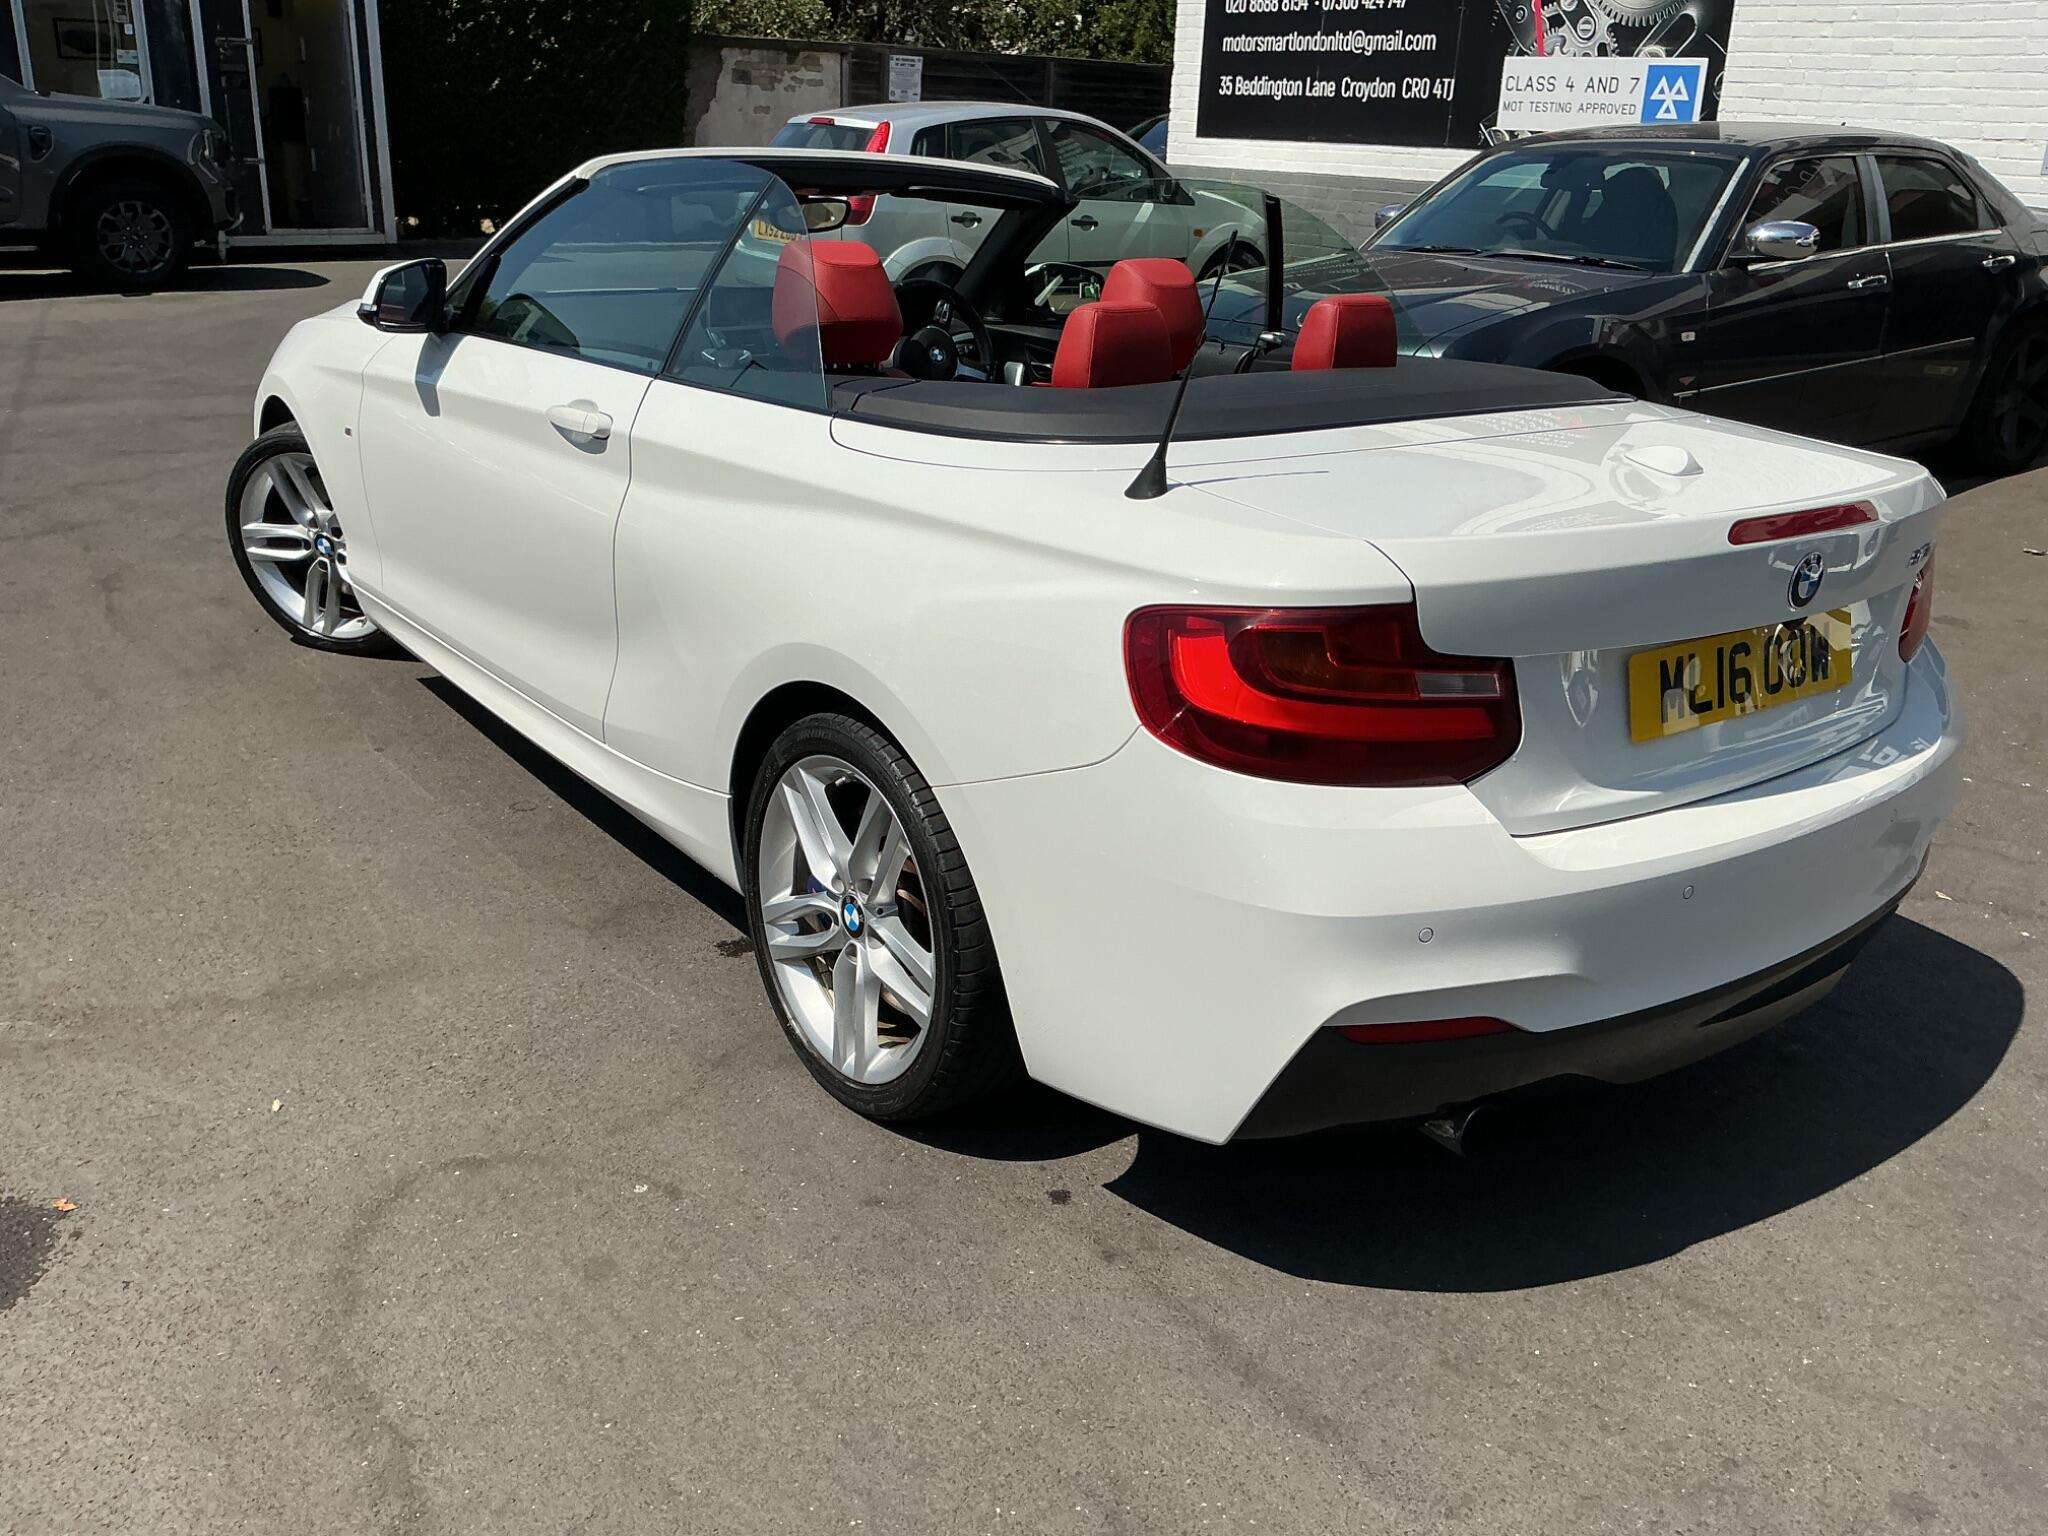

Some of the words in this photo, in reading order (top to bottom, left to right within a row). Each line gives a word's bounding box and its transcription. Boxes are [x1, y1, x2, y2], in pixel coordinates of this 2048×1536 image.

[1222, 30, 1437, 56] motorsmartlondonltd@gmail.com
[1218, 75, 1233, 96] 35
[1234, 75, 1303, 101] Beddington
[1305, 76, 1336, 97] Lane
[1341, 76, 1396, 102] Croydon
[1432, 78, 1456, 101] 4TJ
[1504, 75, 1557, 93] CLASS
[1565, 75, 1576, 93] 4
[1584, 76, 1620, 94] AND
[1628, 76, 1642, 95] 7
[1502, 100, 1524, 113] MOT
[1528, 100, 1573, 114] TESTING
[1577, 102, 1638, 115] APPROVED
[1659, 641, 1752, 725] ML16
